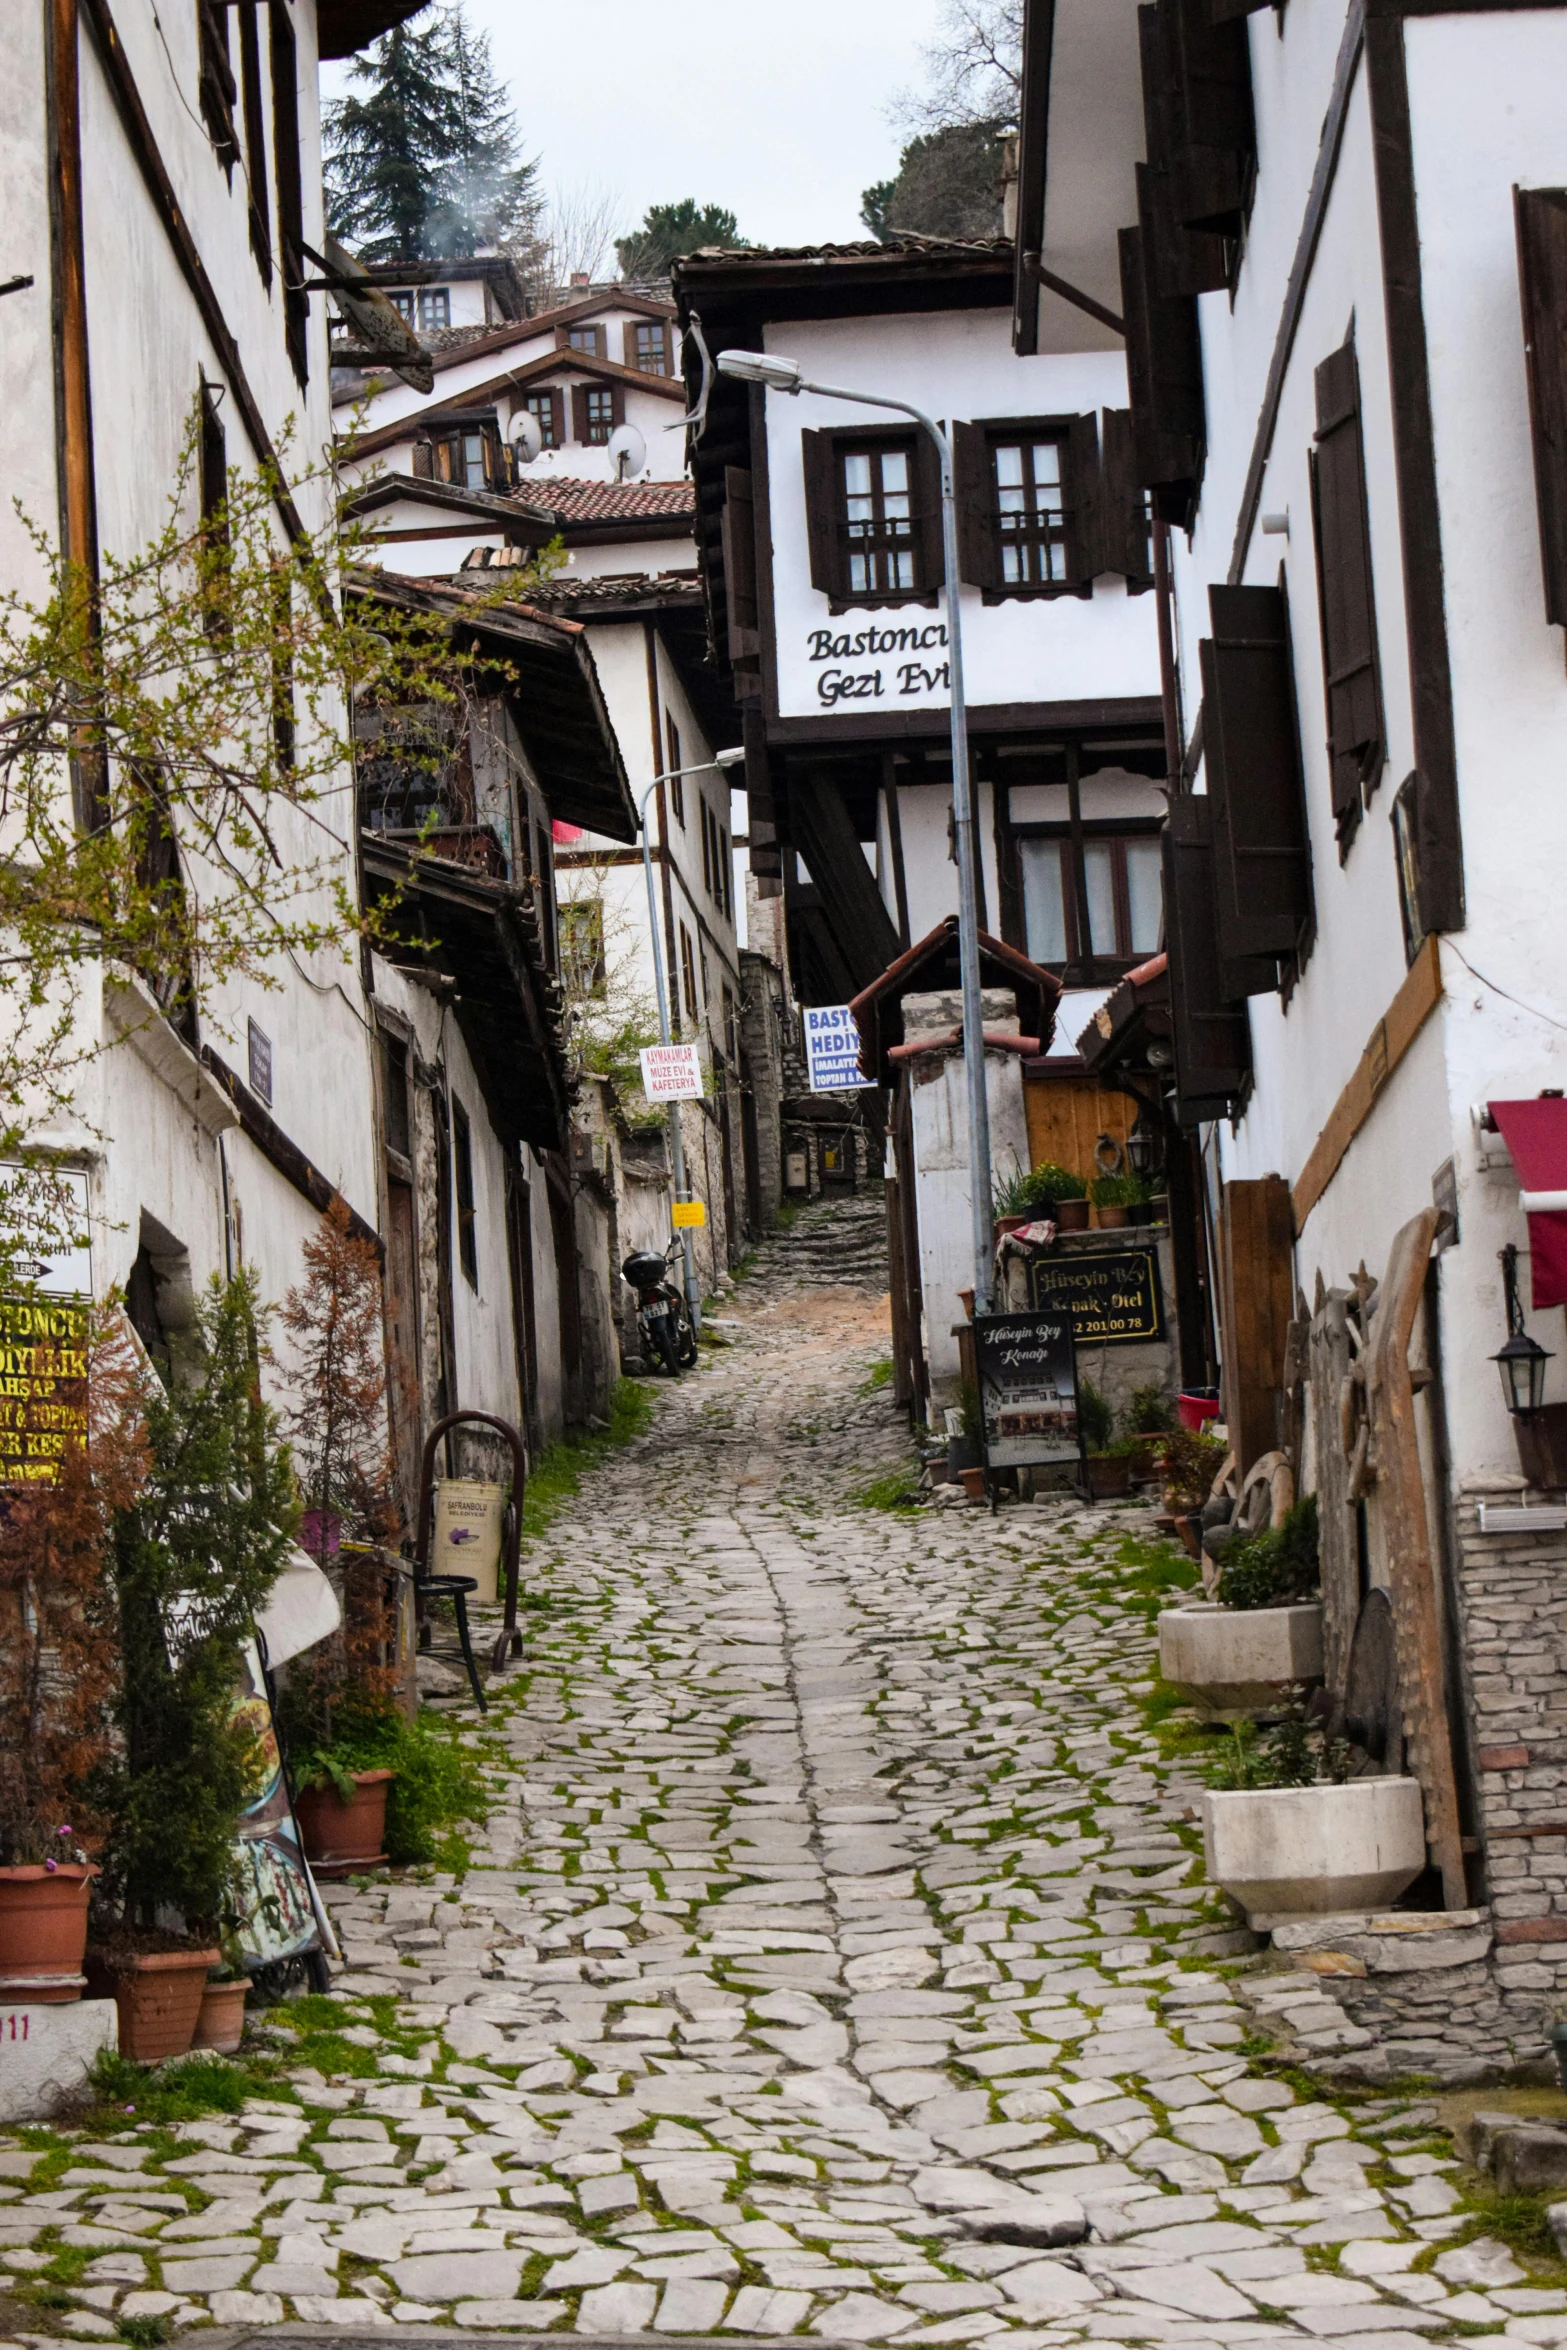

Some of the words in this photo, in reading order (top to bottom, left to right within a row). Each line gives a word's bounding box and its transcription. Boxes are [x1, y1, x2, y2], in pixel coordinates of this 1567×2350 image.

[817, 669, 885, 707] Gezi
[897, 662, 950, 694] Evi
[646, 1047, 693, 1065] KAYMAKAMLAR
[650, 1065, 672, 1078] MÜZE
[673, 1063, 686, 1077] EVİ
[687, 1068, 694, 1076] &
[815, 1073, 846, 1086] TOPTAN
[848, 1072, 855, 1083] &
[652, 1077, 696, 1092] KAFETERYA
[1040, 1269, 1108, 1293] Hüseyin
[1111, 1291, 1143, 1309] Otel
[0, 1306, 83, 1338] TONCU
[1086, 1321, 1107, 1332] 201
[1110, 1319, 1125, 1330] 00
[1127, 1318, 1142, 1328] 78
[983, 1326, 1034, 1345] Hüseyin
[1036, 1324, 1061, 1343] Bey
[1000, 1347, 1048, 1367] Konağı
[447, 1501, 487, 1511] SAFRANBOLU
